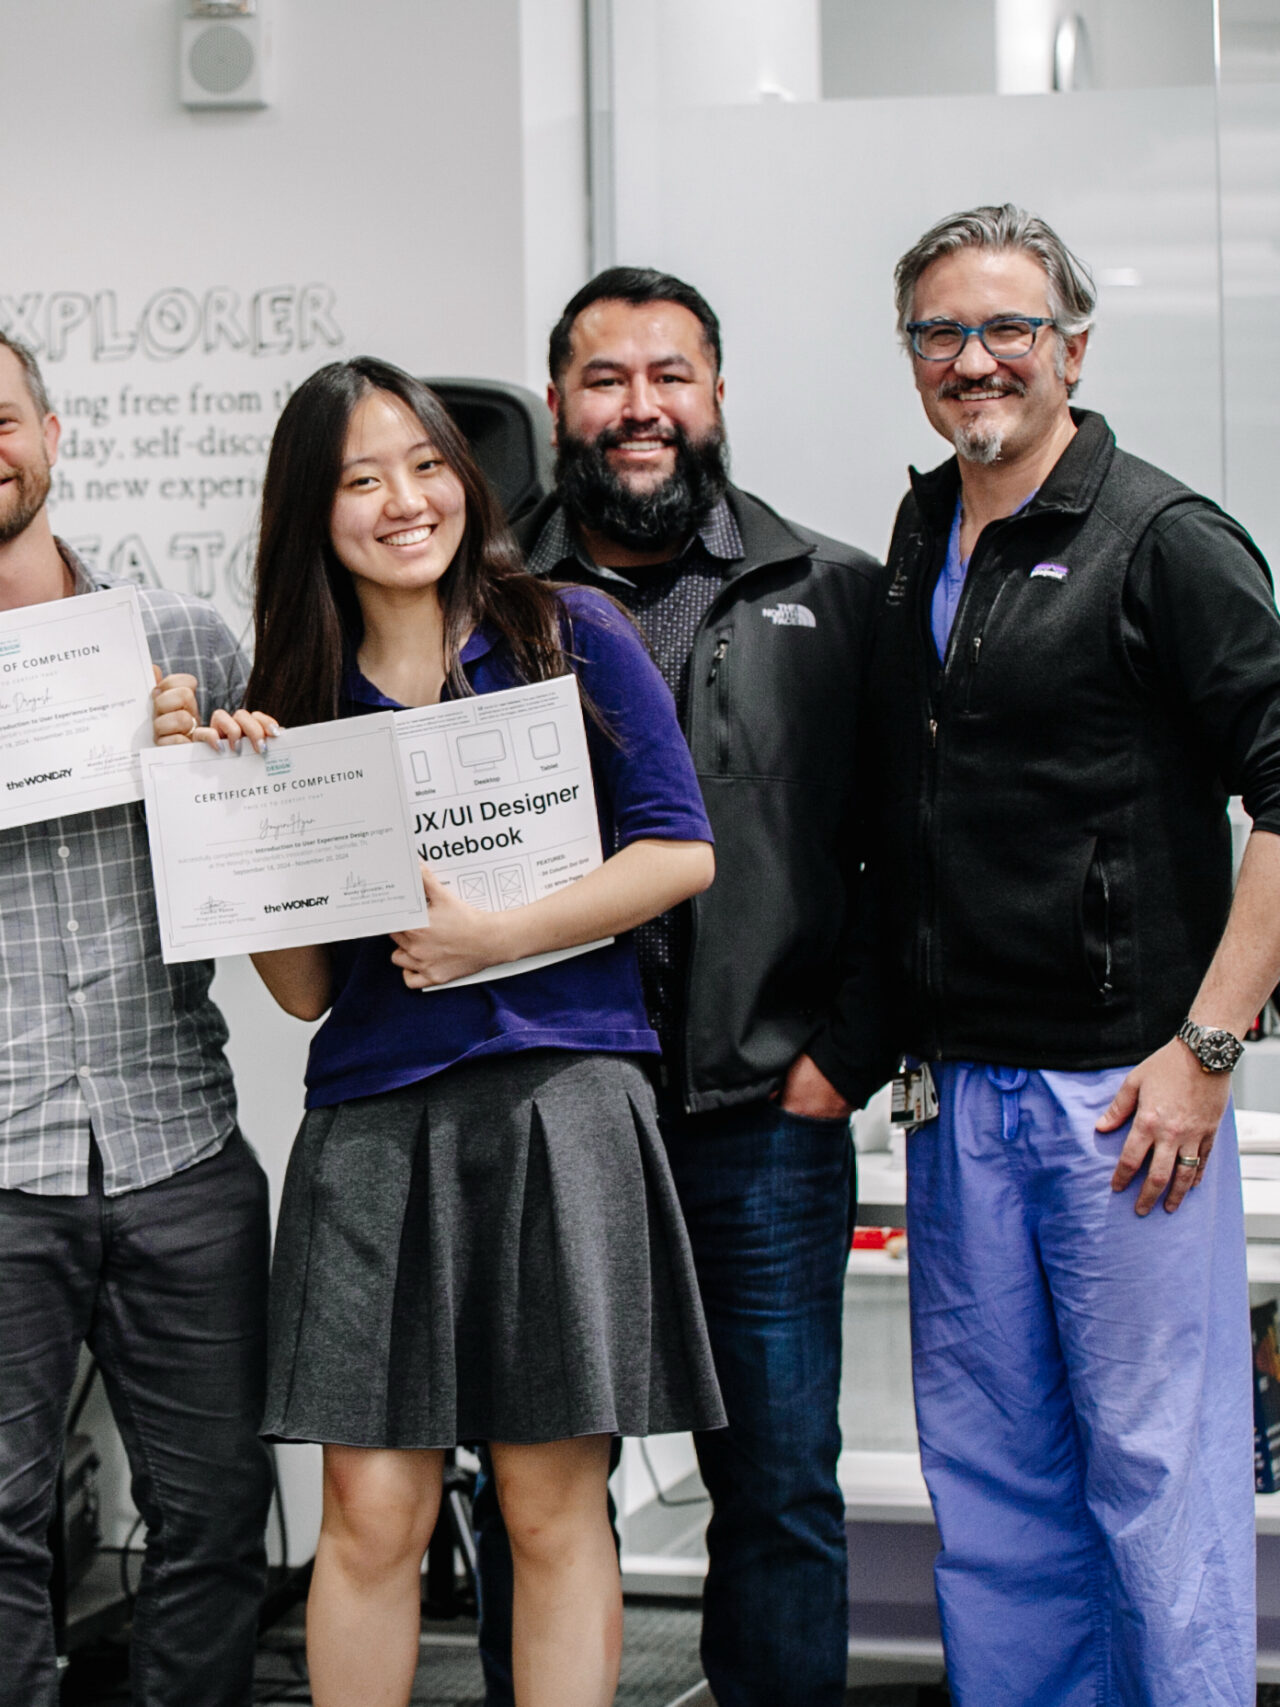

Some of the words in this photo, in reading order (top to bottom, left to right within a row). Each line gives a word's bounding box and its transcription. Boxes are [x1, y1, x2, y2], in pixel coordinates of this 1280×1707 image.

[118, 385, 180, 417] free
[190, 383, 262, 415] from
[85, 476, 150, 501] new
[159, 467, 262, 509] experi
[3, 662, 18, 673] OF
[22, 644, 101, 669] COMPLETION
[54, 709, 88, 720] Experience
[88, 704, 110, 713] Design
[265, 763, 291, 772] DESIGN
[539, 763, 559, 772] Tablet
[194, 785, 269, 804] CERTIFICATE
[273, 782, 287, 793] OF
[291, 769, 364, 790] COMPLETION
[414, 788, 437, 797] Mobile
[473, 776, 501, 786] Desktop
[479, 784, 580, 822] Designer
[254, 844, 294, 854] Introduction
[316, 834, 349, 845] Experience
[349, 831, 370, 839] Design
